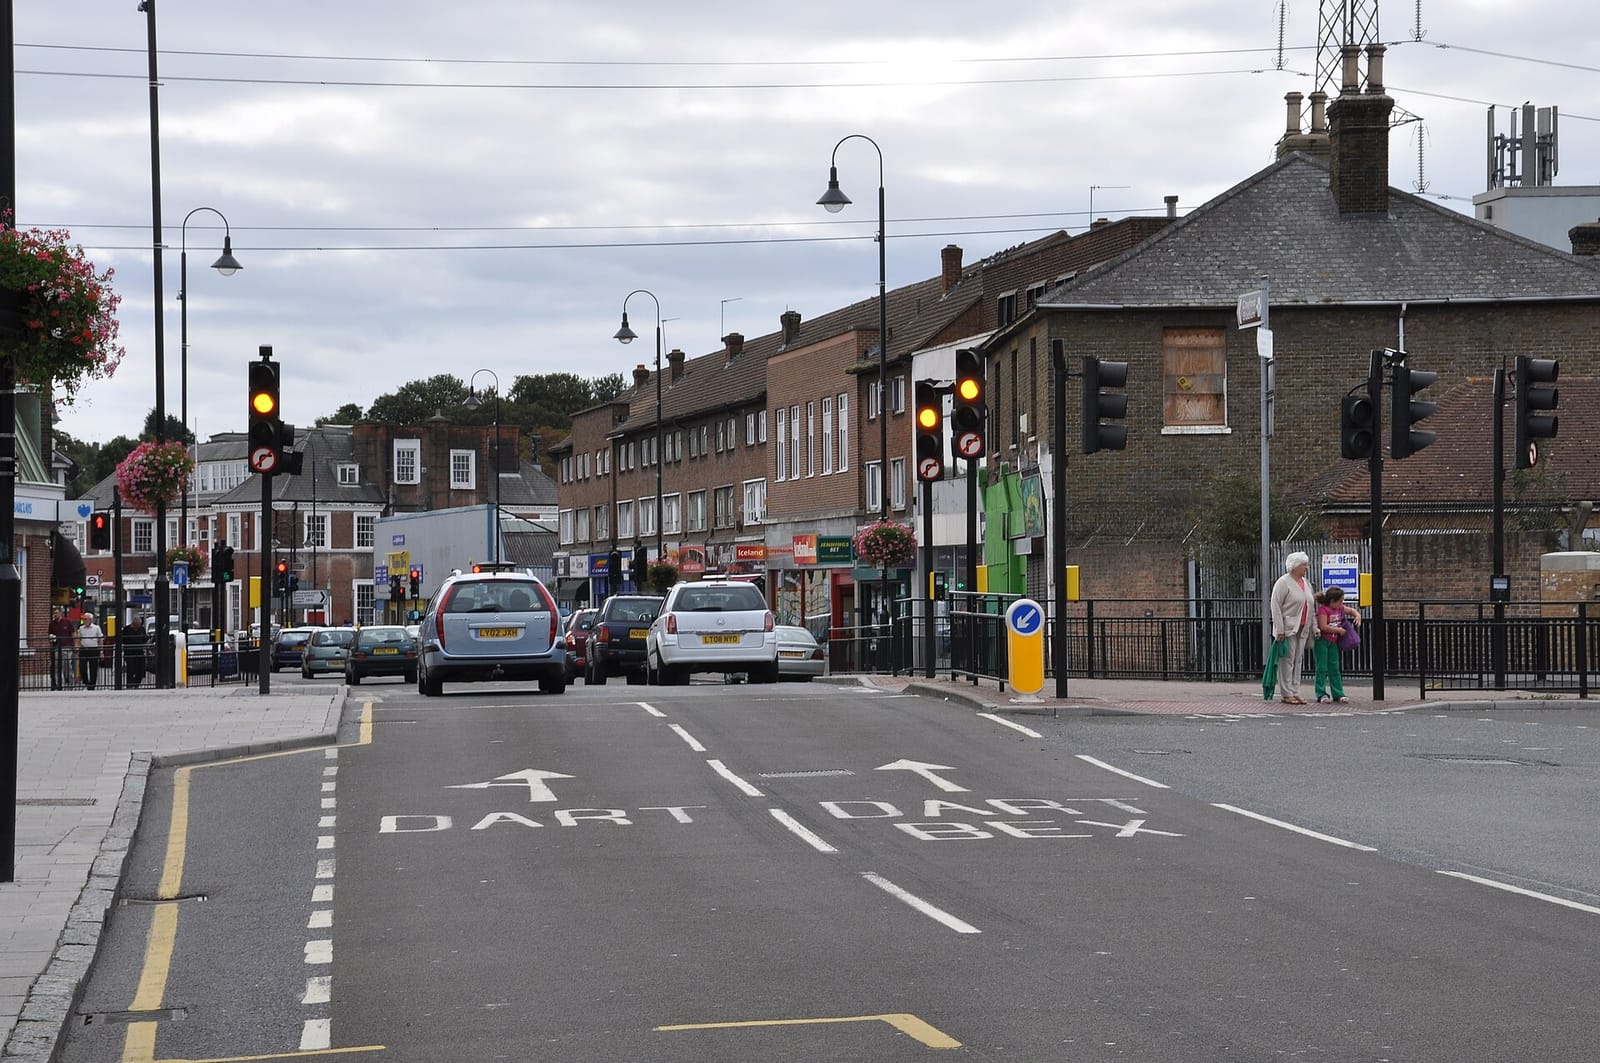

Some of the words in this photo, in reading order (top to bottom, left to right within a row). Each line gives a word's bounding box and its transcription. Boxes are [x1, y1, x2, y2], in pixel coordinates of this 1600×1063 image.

[1343, 555, 1358, 564] Erith
[479, 628, 500, 638] LY02
[502, 628, 518, 638] JXH
[819, 798, 1148, 819] DART
[378, 805, 707, 833] DART
[893, 820, 1187, 840] BEX
